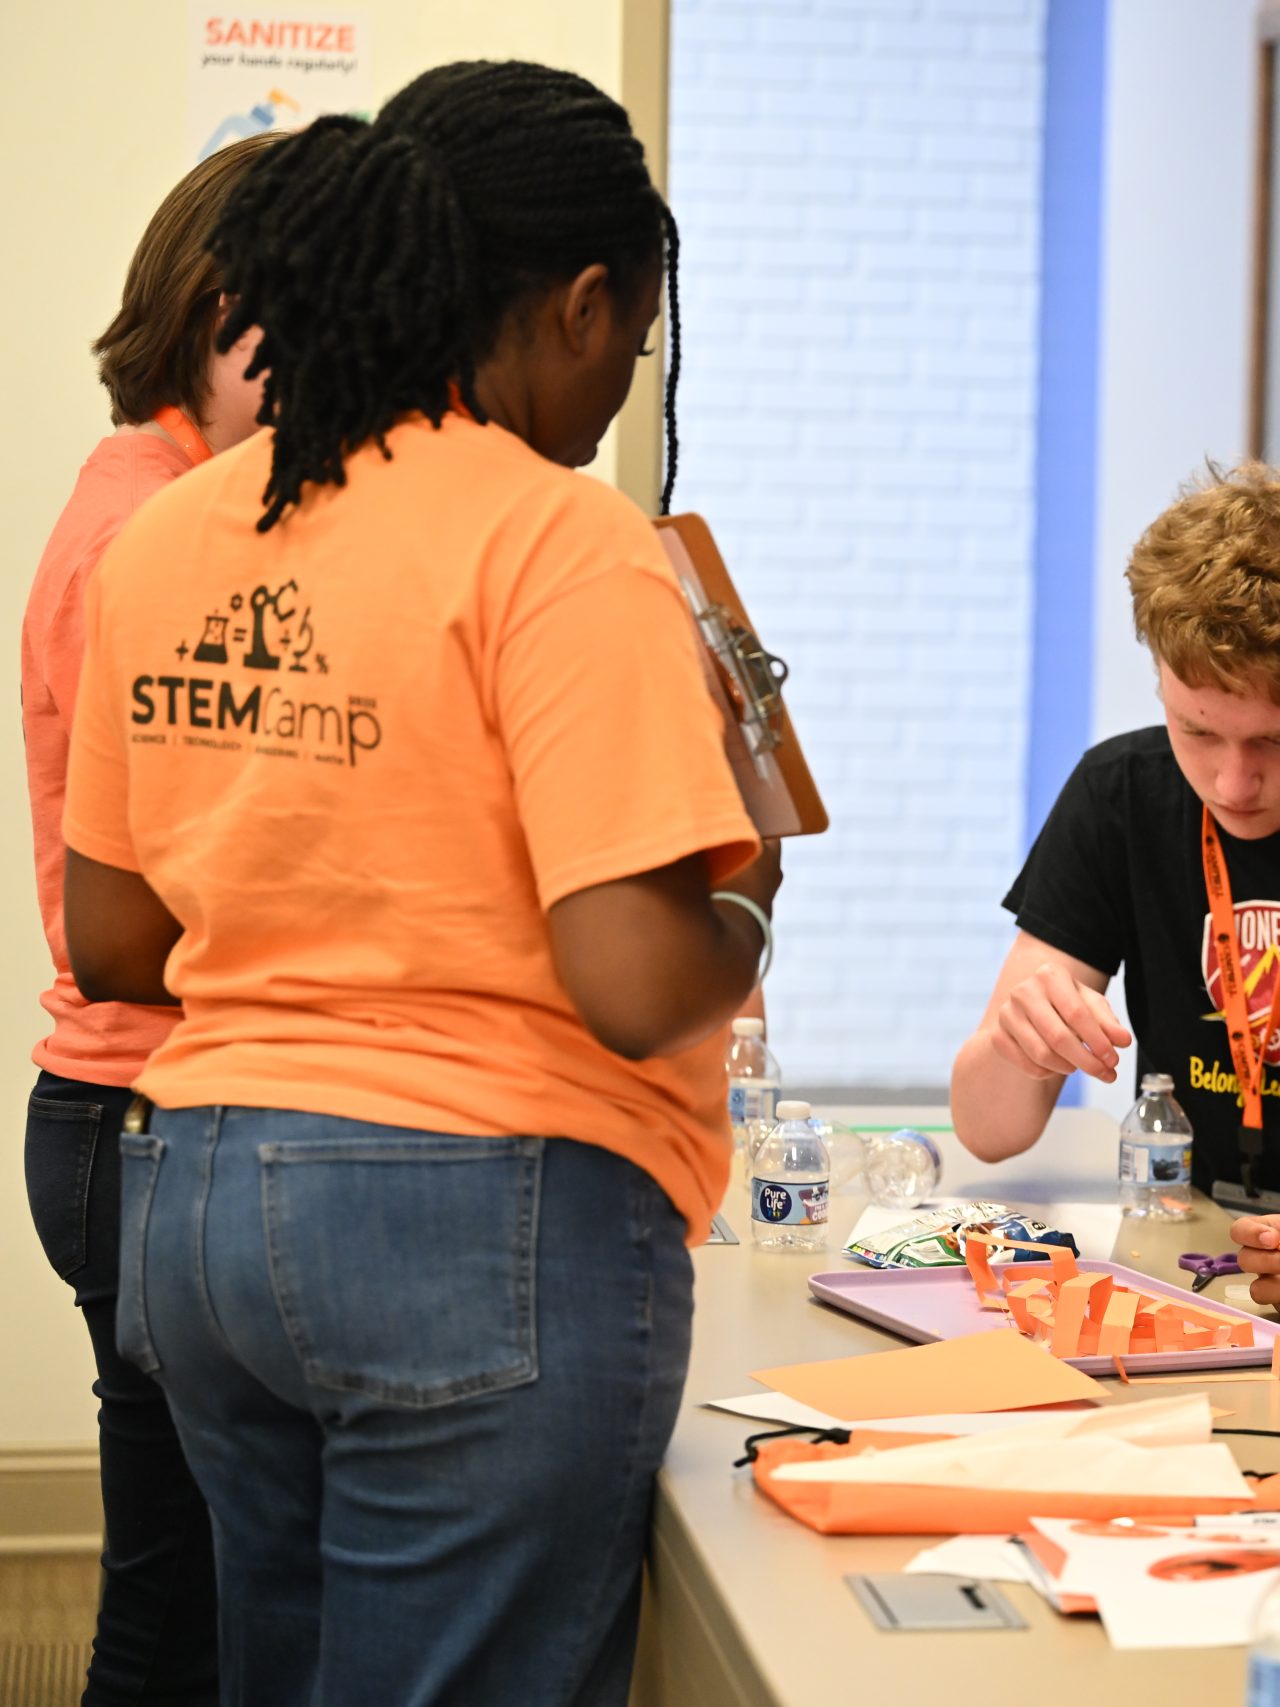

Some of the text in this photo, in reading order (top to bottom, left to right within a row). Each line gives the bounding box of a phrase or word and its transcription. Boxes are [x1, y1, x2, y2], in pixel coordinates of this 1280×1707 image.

[206, 18, 354, 51] SANITIZE
[201, 54, 234, 68] your
[239, 53, 282, 67] hands
[765, 1188, 786, 1199] Pure
[767, 1199, 783, 1210] Life
